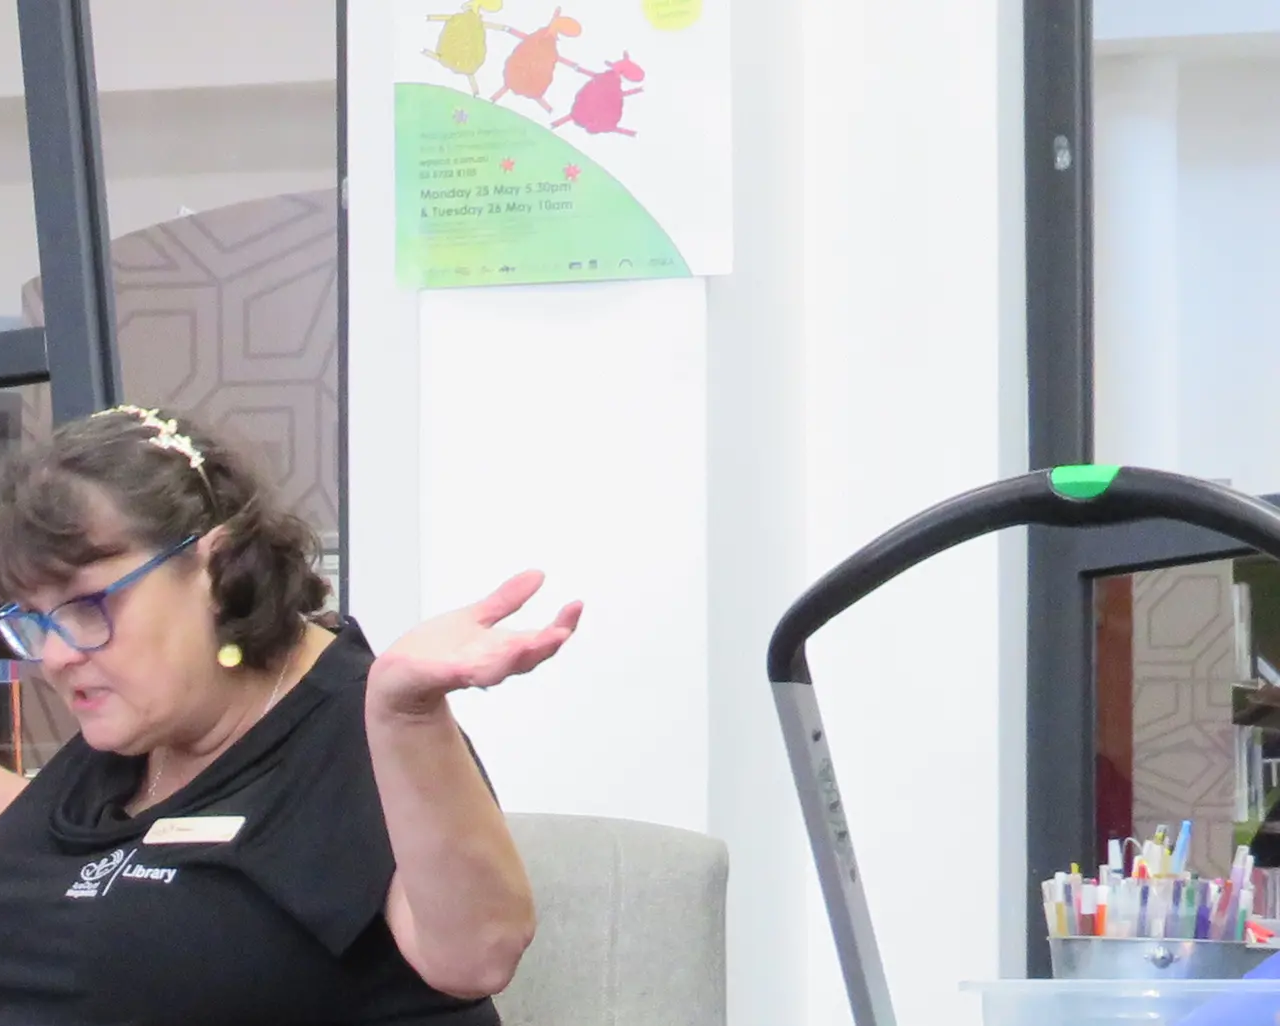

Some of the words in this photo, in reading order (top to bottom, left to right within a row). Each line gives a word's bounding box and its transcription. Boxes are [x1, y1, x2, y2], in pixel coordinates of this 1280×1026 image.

[420, 188, 472, 200] Monday
[493, 184, 522, 196] May
[432, 205, 484, 218] Tuesday
[487, 203, 501, 214] 26
[505, 202, 532, 214] May
[538, 200, 574, 211] 10am
[122, 863, 178, 884] Library
